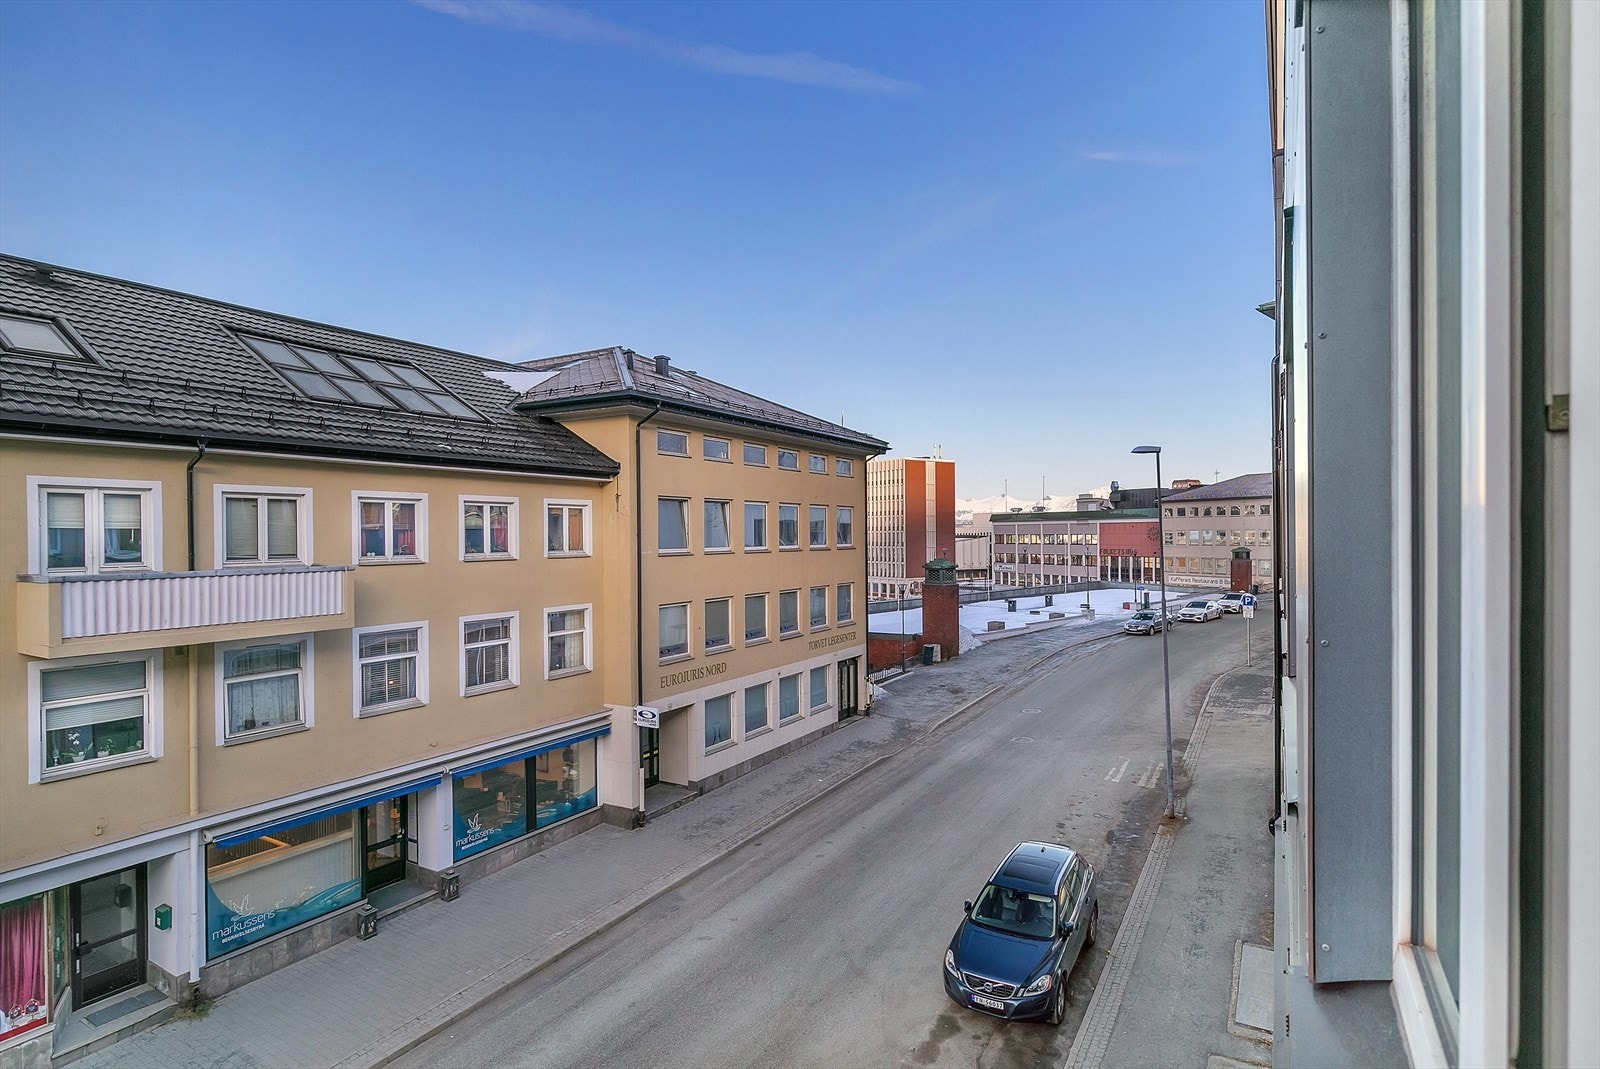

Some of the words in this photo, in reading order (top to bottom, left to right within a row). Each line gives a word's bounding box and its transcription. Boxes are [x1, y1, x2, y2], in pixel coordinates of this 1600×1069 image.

[1245, 597, 1251, 605] P
[808, 638, 827, 652] TORVET
[828, 632, 856, 647] LEGESENTER
[660, 666, 705, 688] EUROJURIS
[705, 661, 727, 678] NORD
[456, 826, 495, 847] markussens
[212, 909, 275, 940] markussens
[221, 923, 265, 944] BEGRAVELSESBYRÅ
